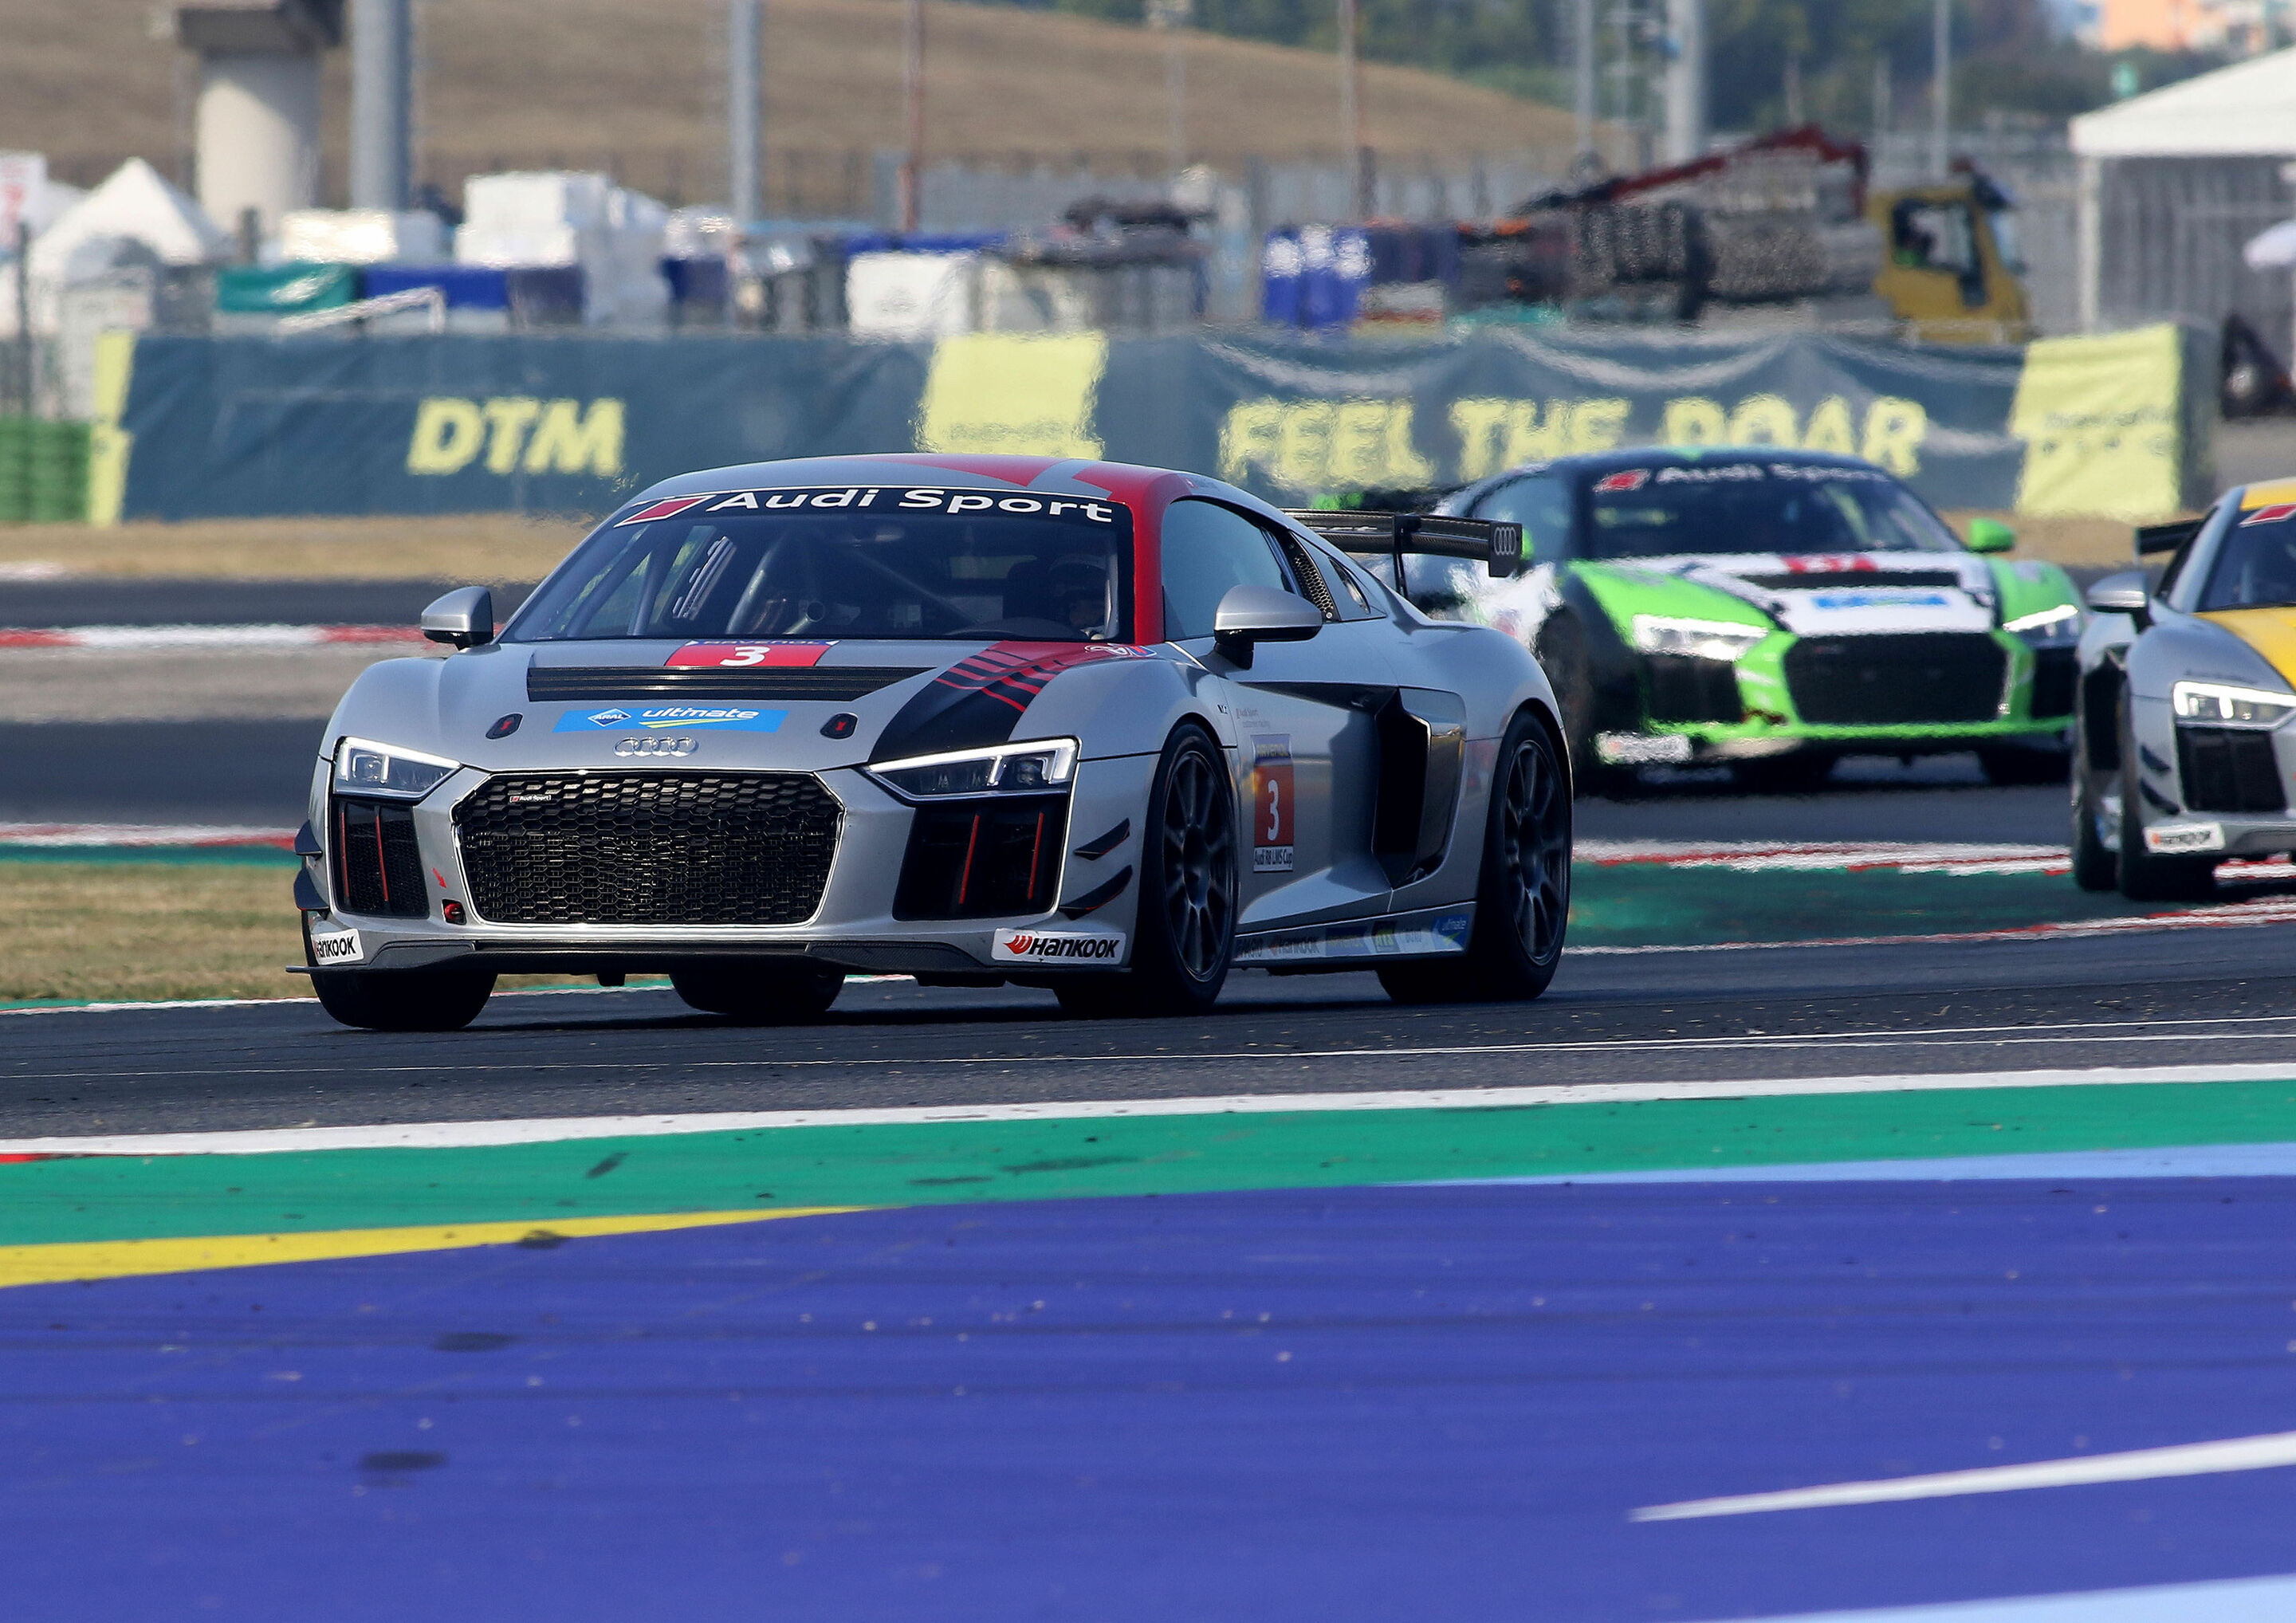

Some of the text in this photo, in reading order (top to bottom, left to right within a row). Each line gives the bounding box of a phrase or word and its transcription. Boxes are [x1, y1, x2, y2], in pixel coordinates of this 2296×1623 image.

[406, 396, 625, 476] DTM
[1217, 394, 1435, 489] FEEL
[1448, 394, 1633, 481] THE
[706, 488, 1113, 523] Audi Sport
[719, 645, 772, 667] 3
[641, 706, 760, 719] ultimate
[1267, 779, 1280, 842] 3
[1254, 849, 1265, 867] Audi
[1272, 850, 1283, 866] LMS
[1283, 849, 1293, 869] Cup
